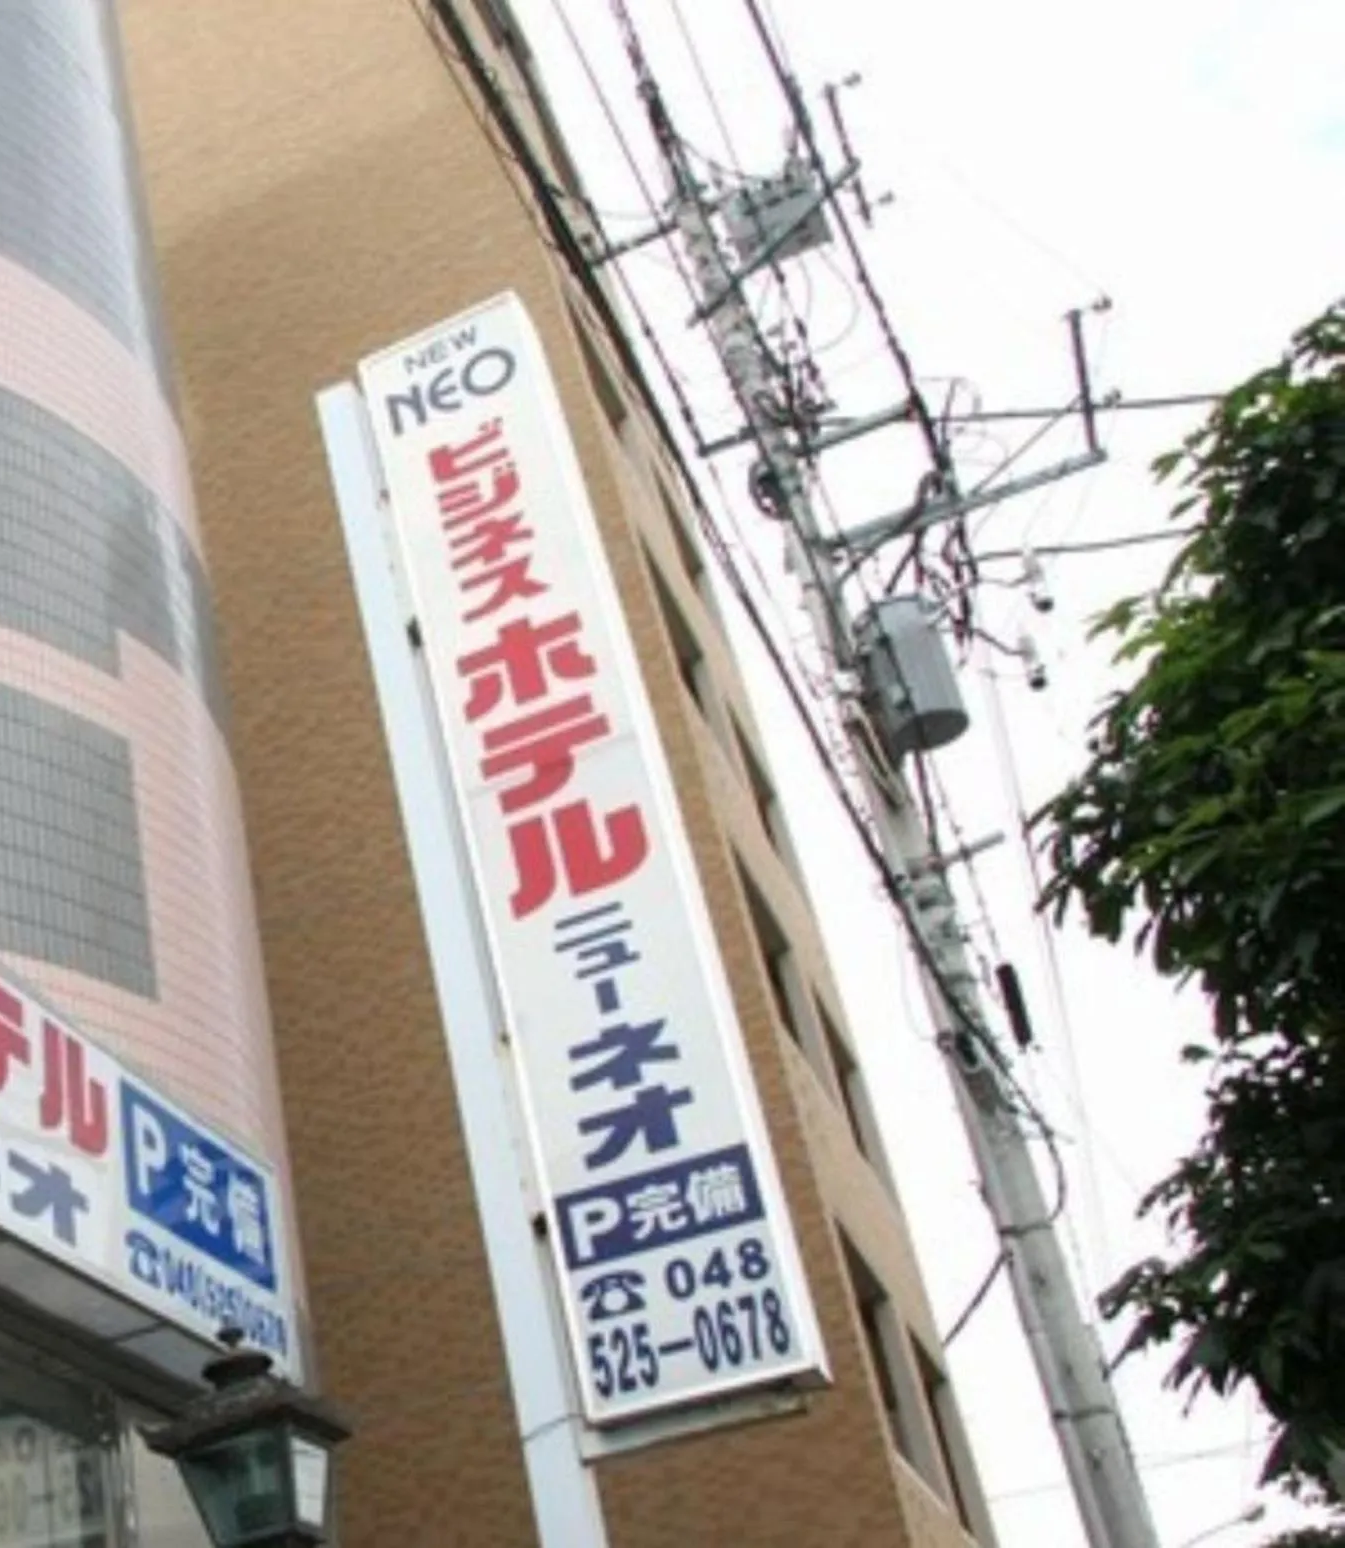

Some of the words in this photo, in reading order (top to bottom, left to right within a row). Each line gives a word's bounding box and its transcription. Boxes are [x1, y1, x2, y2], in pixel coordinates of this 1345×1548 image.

[386, 346, 517, 437] NEO
[404, 325, 477, 375] NEW
[428, 417, 550, 623] ビジネス
[457, 611, 648, 919] ホテル
[664, 1237, 771, 1302] 048
